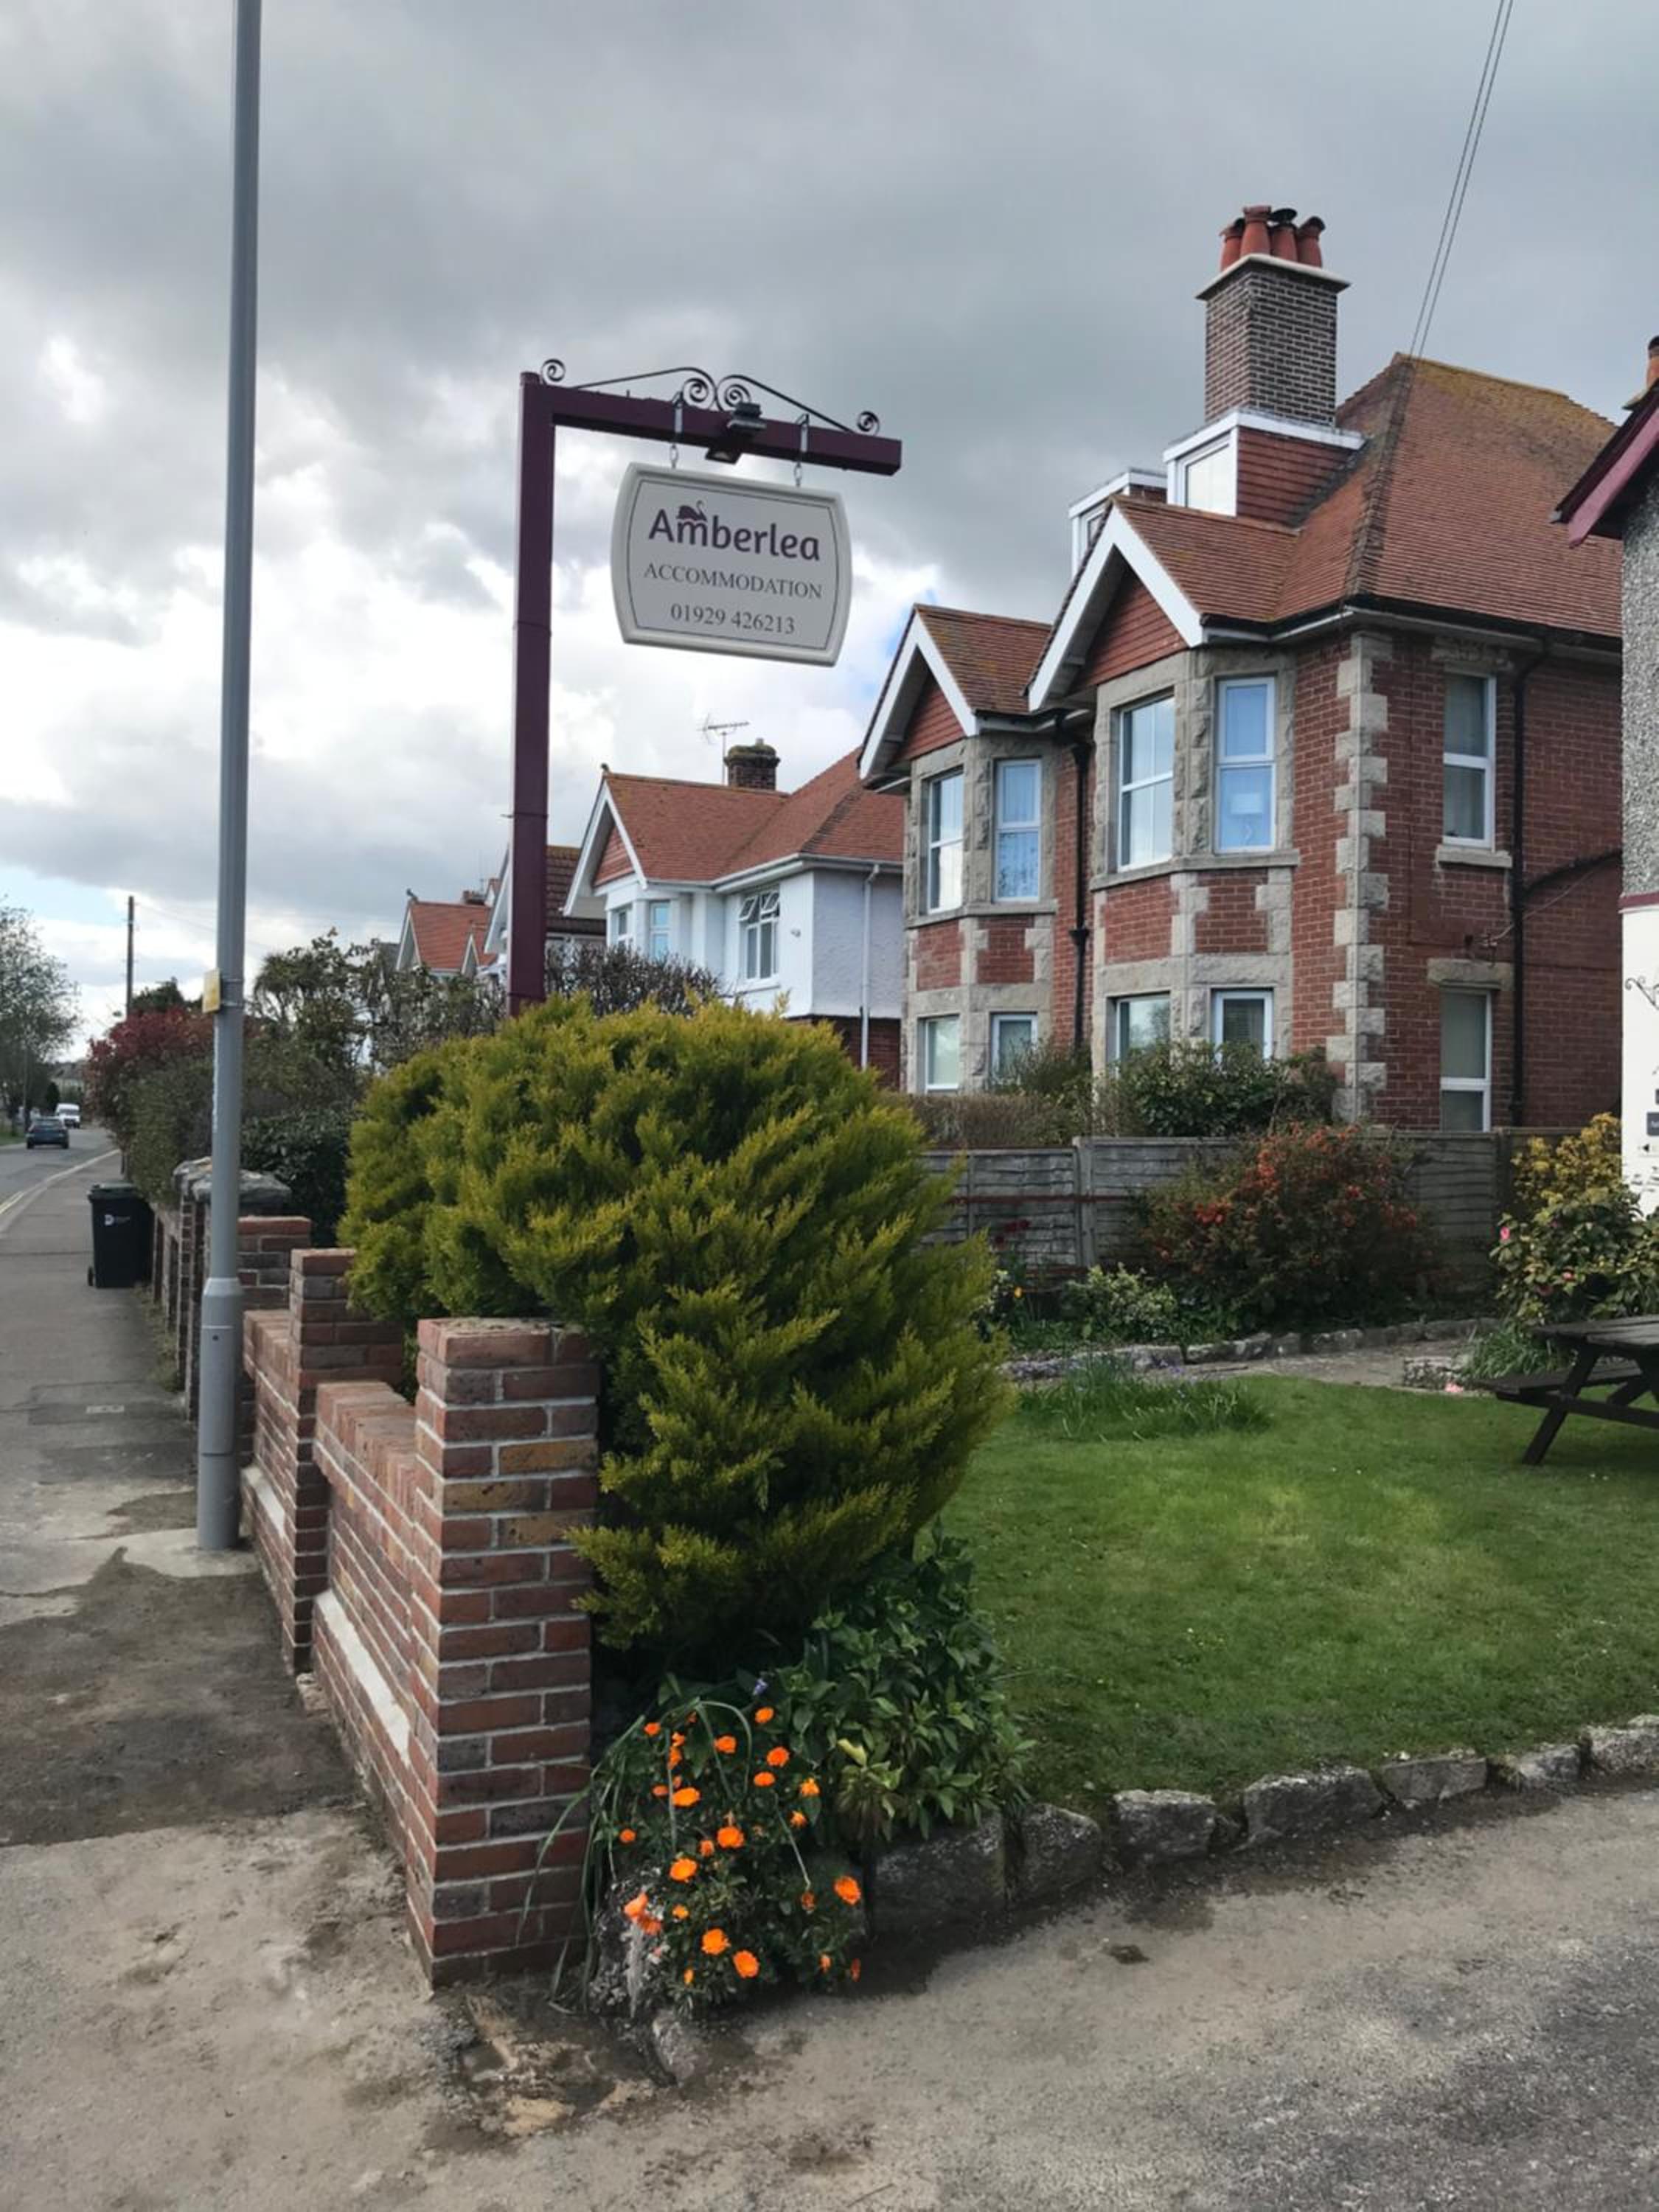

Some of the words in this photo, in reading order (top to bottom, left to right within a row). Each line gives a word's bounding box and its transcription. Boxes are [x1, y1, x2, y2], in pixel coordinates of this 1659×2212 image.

[648, 508, 820, 561] Amberlea
[644, 563, 823, 599] ACCOMMODATION
[670, 603, 726, 625] 01929
[731, 611, 795, 634] 426213
